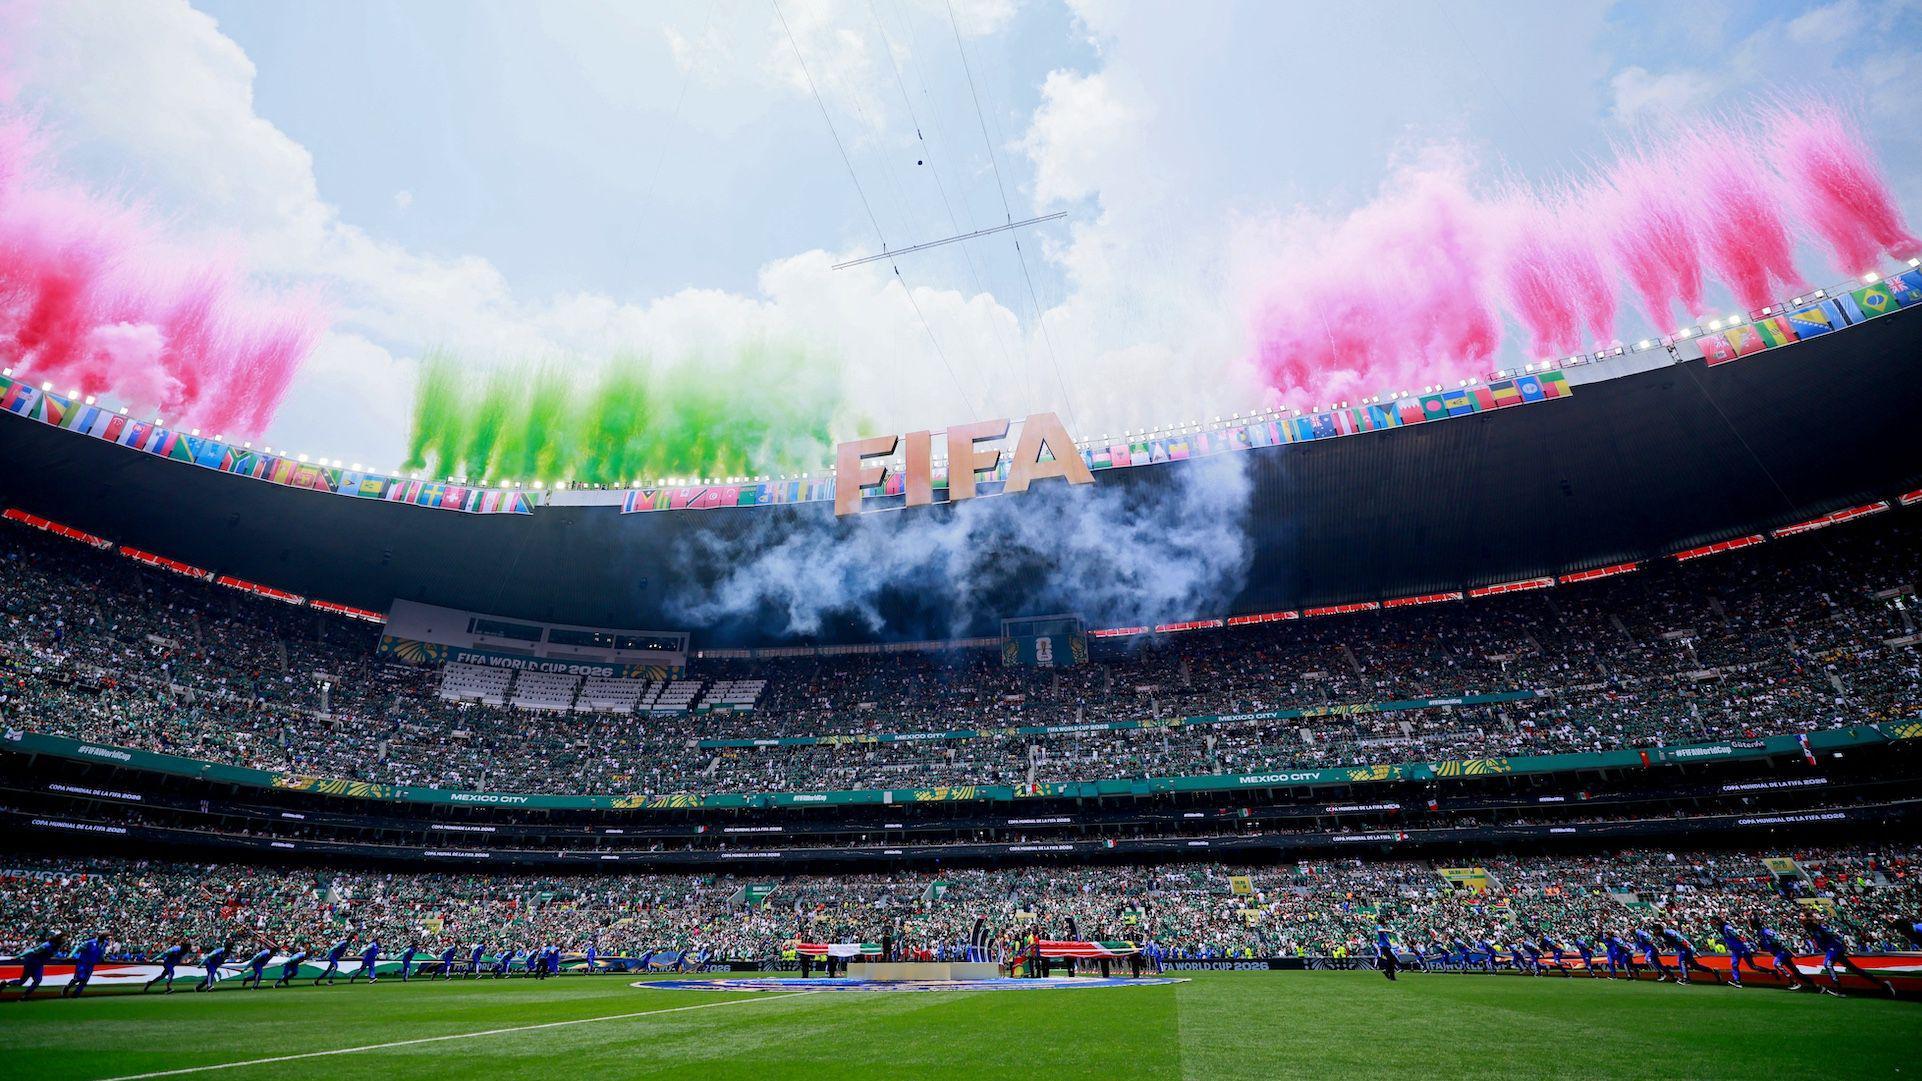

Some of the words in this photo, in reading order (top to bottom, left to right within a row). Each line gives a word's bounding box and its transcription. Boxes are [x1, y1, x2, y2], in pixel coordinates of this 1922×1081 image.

[834, 411, 1096, 517] FIFA
[456, 652, 486, 664] FIFA
[489, 656, 539, 672] WORLD
[540, 662, 568, 673] CUP
[568, 664, 614, 677] 2026
[78, 745, 131, 761] #FIFAWorldCup
[1676, 746, 1732, 757] #FIFAWorldCup
[1239, 774, 1289, 784] MEXICO
[66, 786, 92, 795] MUNDIAL
[450, 794, 498, 802] MEXICO
[49, 820, 75, 829] MUNDIAL
[1175, 962, 1212, 970] WORLD
[1212, 962, 1232, 970] CUP
[1234, 962, 1269, 971] 2026
